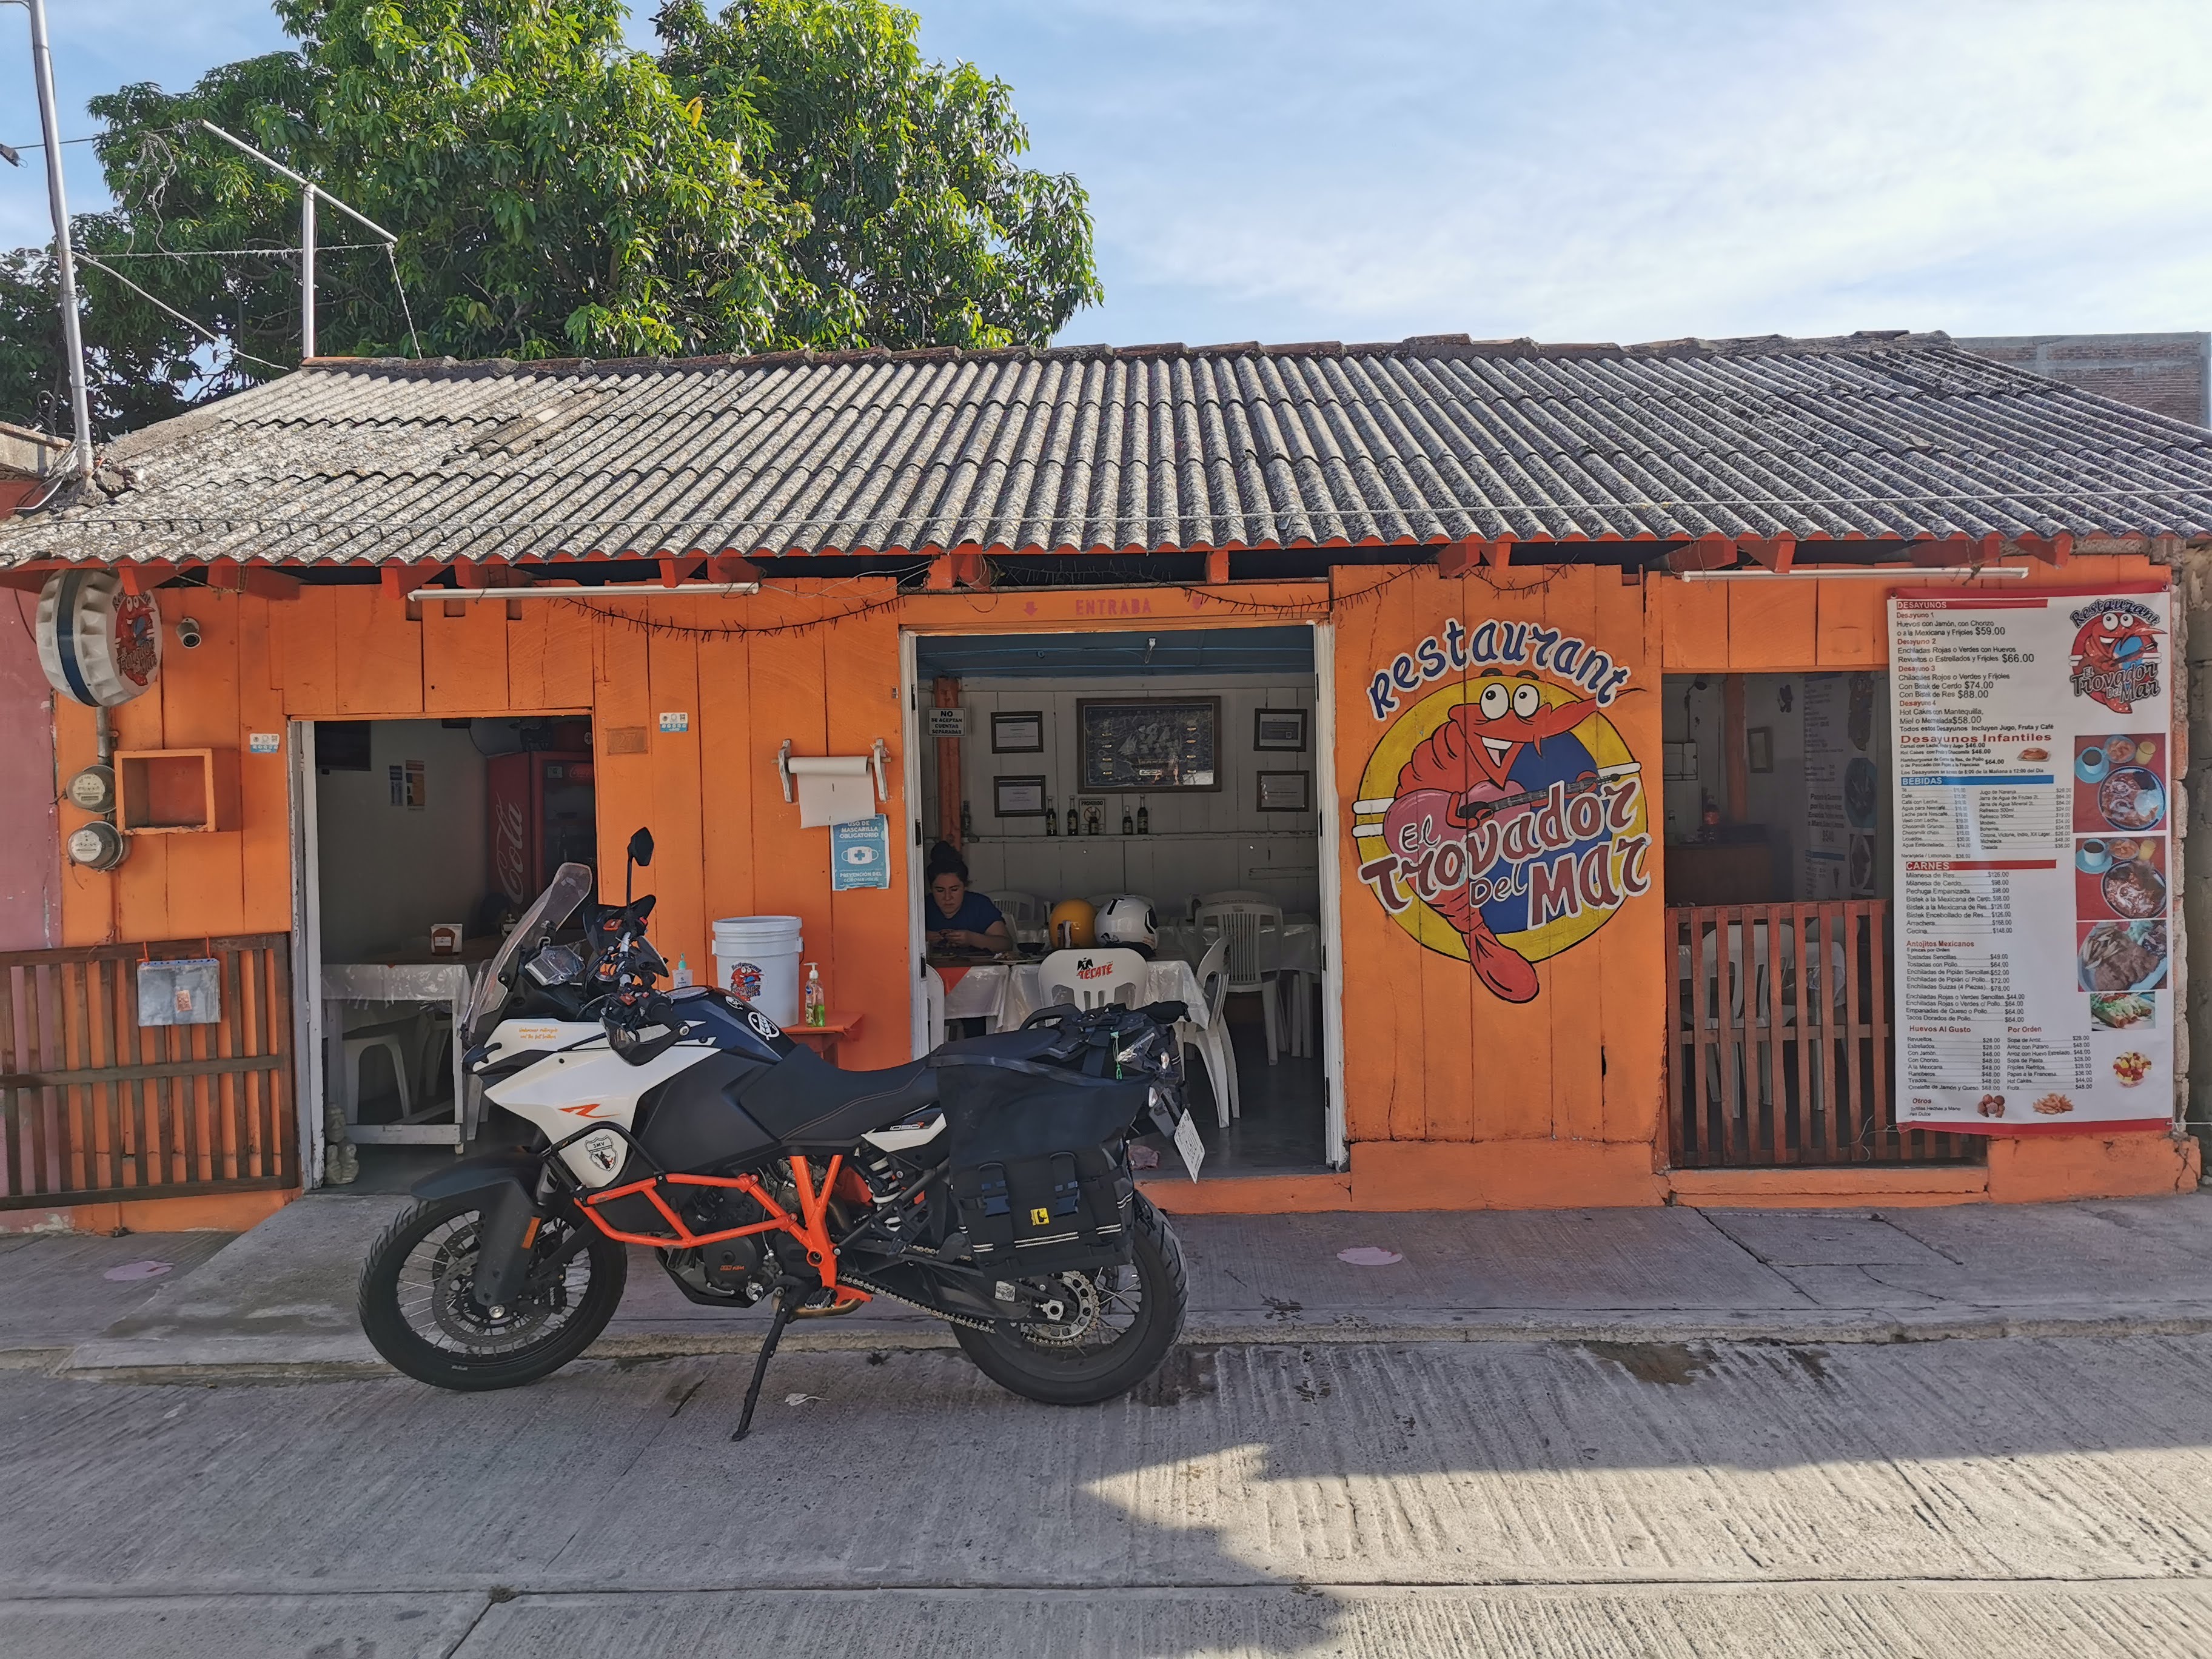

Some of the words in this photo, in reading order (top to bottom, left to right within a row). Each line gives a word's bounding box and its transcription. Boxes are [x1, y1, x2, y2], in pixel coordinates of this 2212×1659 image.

[2070, 598, 2160, 629] Restaurant
[1976, 626, 2005, 635] $59.00
[2002, 654, 2034, 663] $66.00
[1367, 618, 1631, 721] Restaurant
[2083, 665, 2094, 677] El
[2070, 662, 2158, 697] Trovador
[1958, 690, 1988, 699] $88.00
[2119, 678, 2161, 703] Mar
[1952, 716, 1982, 724] $58.00
[1901, 735, 1978, 745] Desayunos
[1983, 734, 2052, 742] Infantiles
[1399, 815, 1441, 852] El
[1358, 777, 1641, 913] Trovador
[1076, 964, 1113, 979] TECATE
